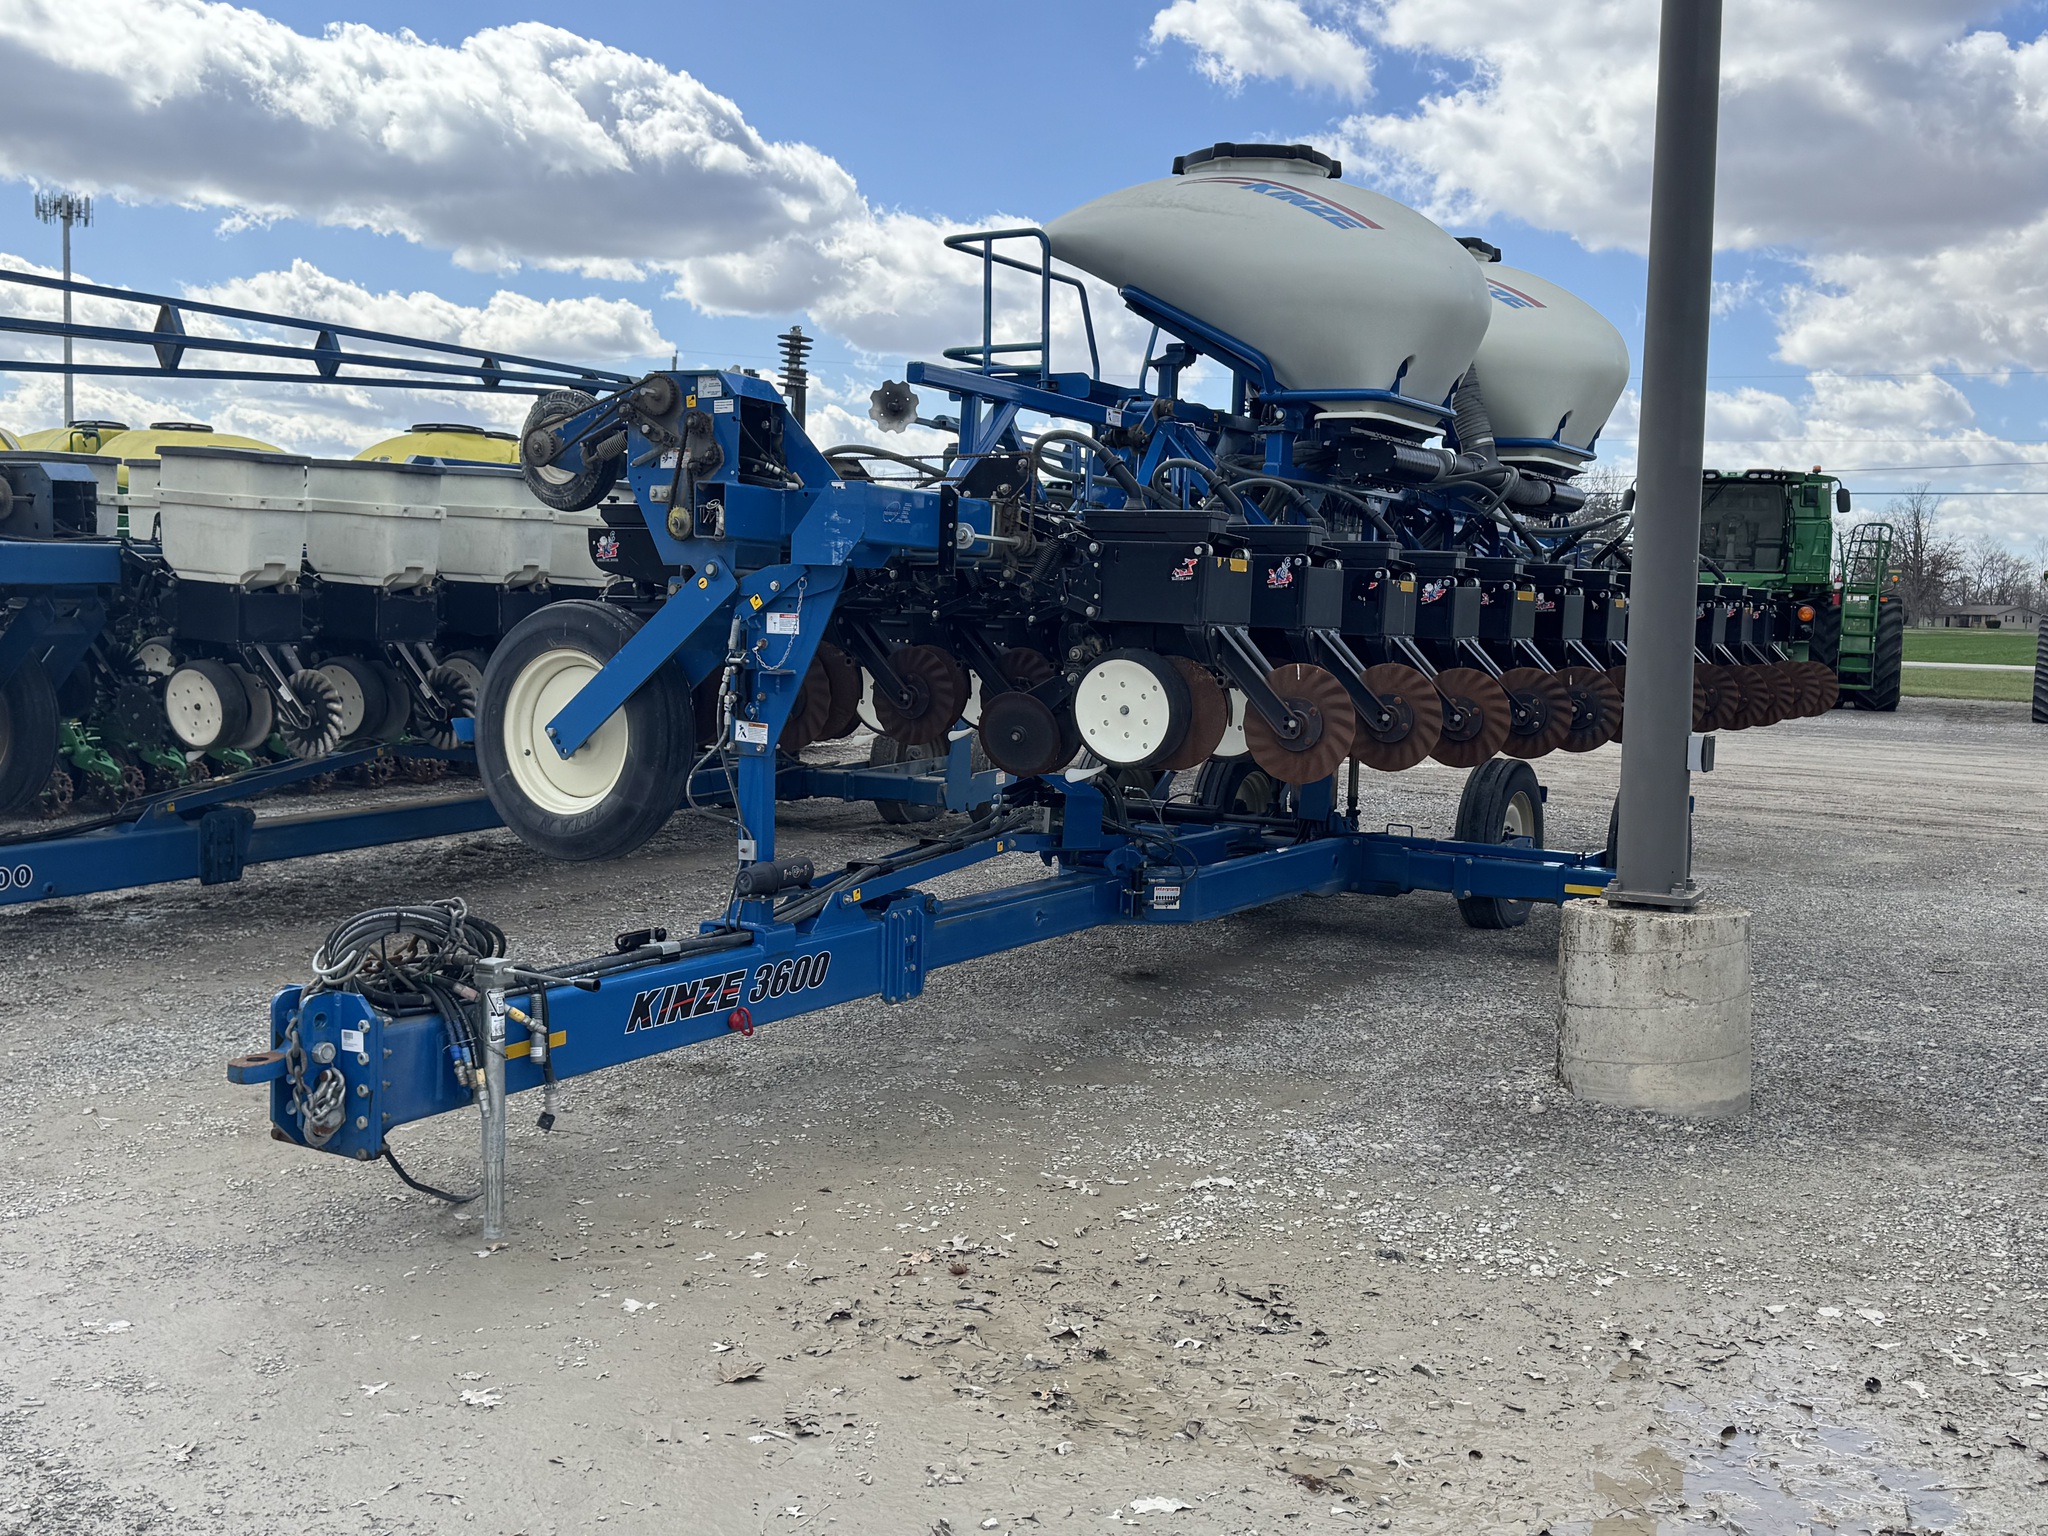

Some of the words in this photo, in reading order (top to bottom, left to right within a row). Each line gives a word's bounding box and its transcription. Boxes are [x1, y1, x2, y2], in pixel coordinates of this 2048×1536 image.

[1239, 182, 1368, 230] KINZE
[624, 968, 748, 1034] KINZE
[748, 950, 832, 1004] 3600
